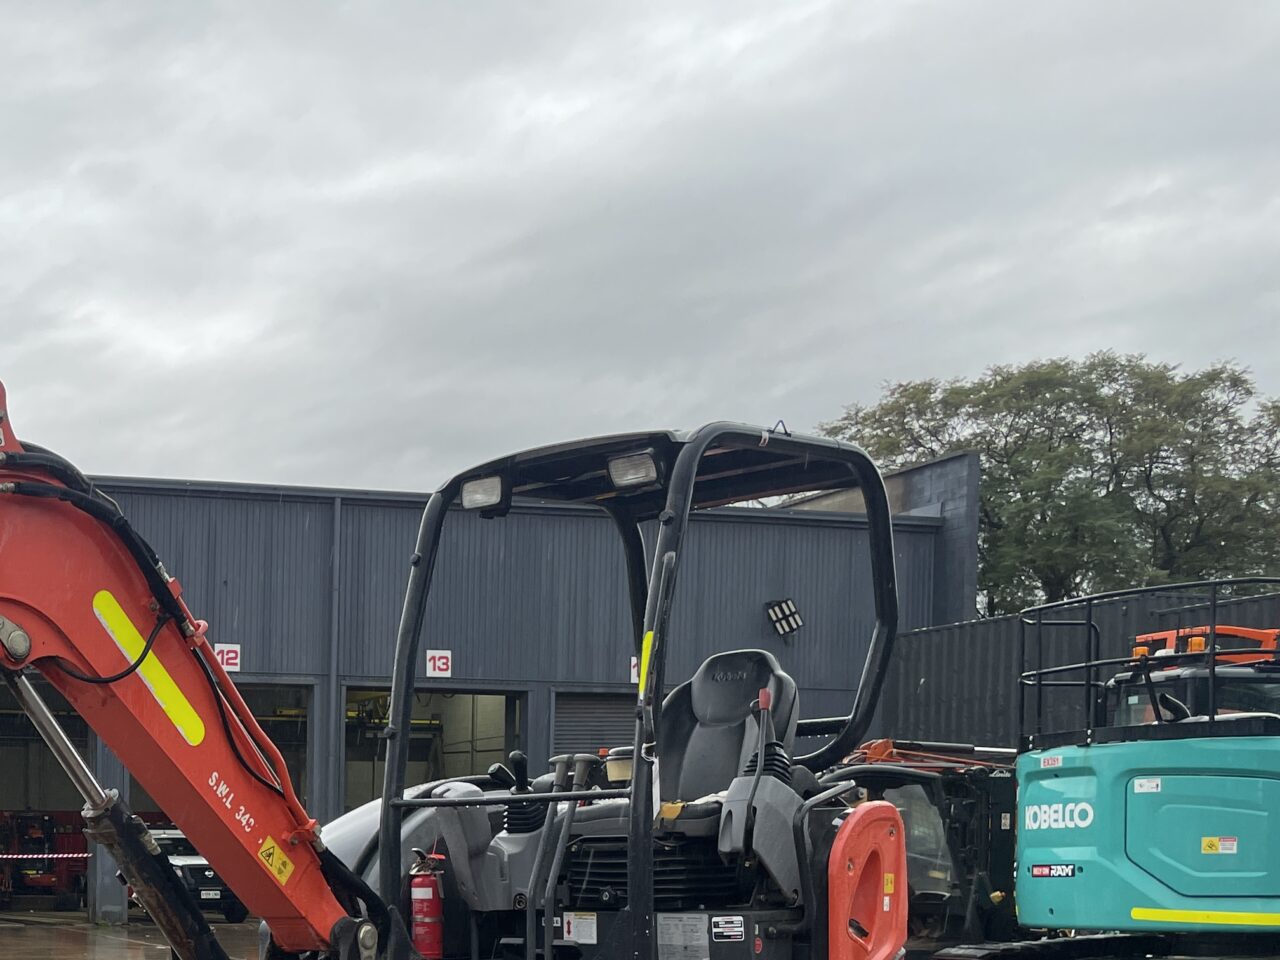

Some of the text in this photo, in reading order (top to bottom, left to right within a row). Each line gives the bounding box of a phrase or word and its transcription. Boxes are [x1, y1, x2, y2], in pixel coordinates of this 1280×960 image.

[216, 649, 239, 667] 12
[428, 655, 450, 672] 13
[1025, 802, 1094, 830] KOBELCO
[1050, 865, 1074, 877] RAM
